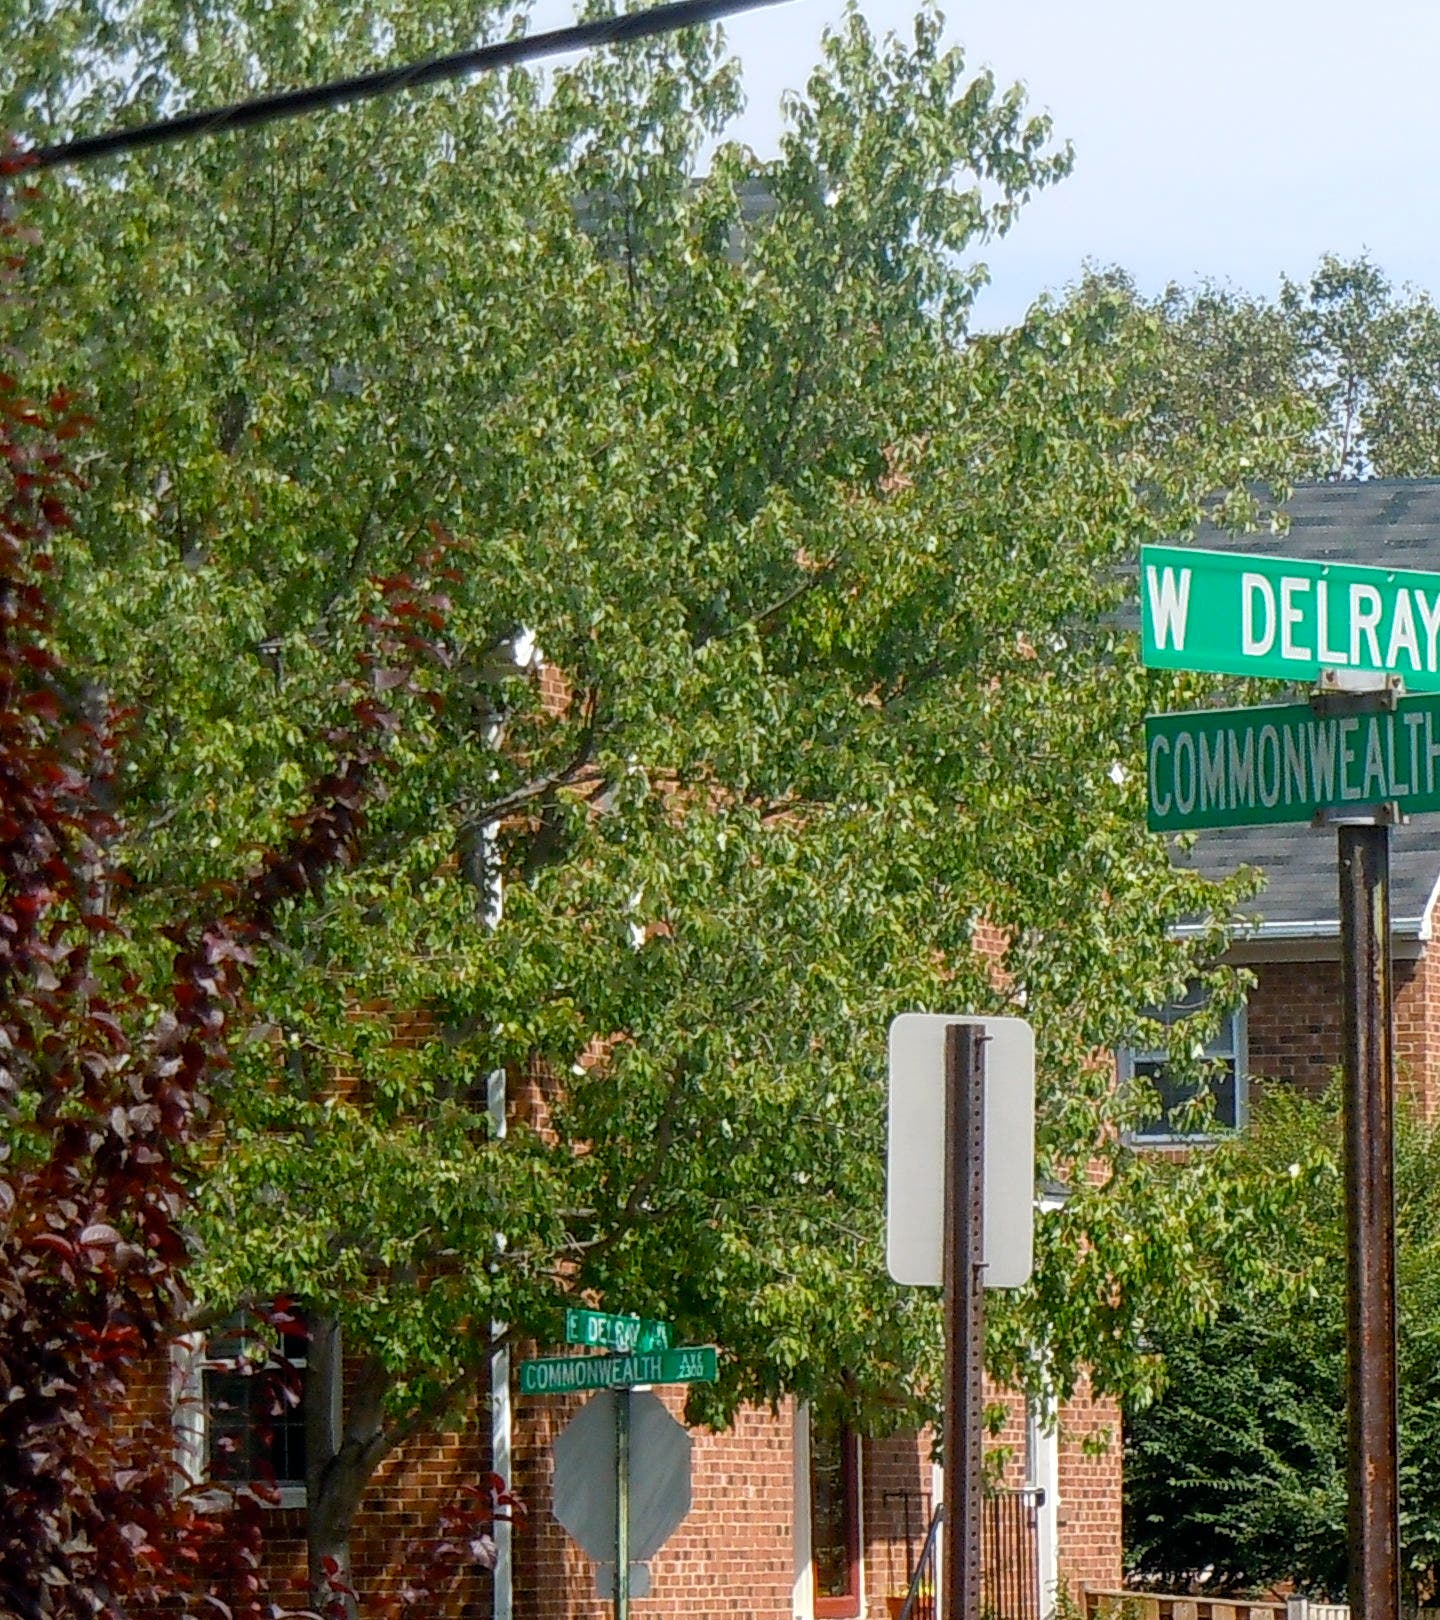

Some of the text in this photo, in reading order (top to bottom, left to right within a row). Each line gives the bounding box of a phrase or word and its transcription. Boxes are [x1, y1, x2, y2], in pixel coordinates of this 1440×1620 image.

[1147, 566, 1192, 651] W
[526, 1352, 703, 1389] COMMONWEALTH AVE
